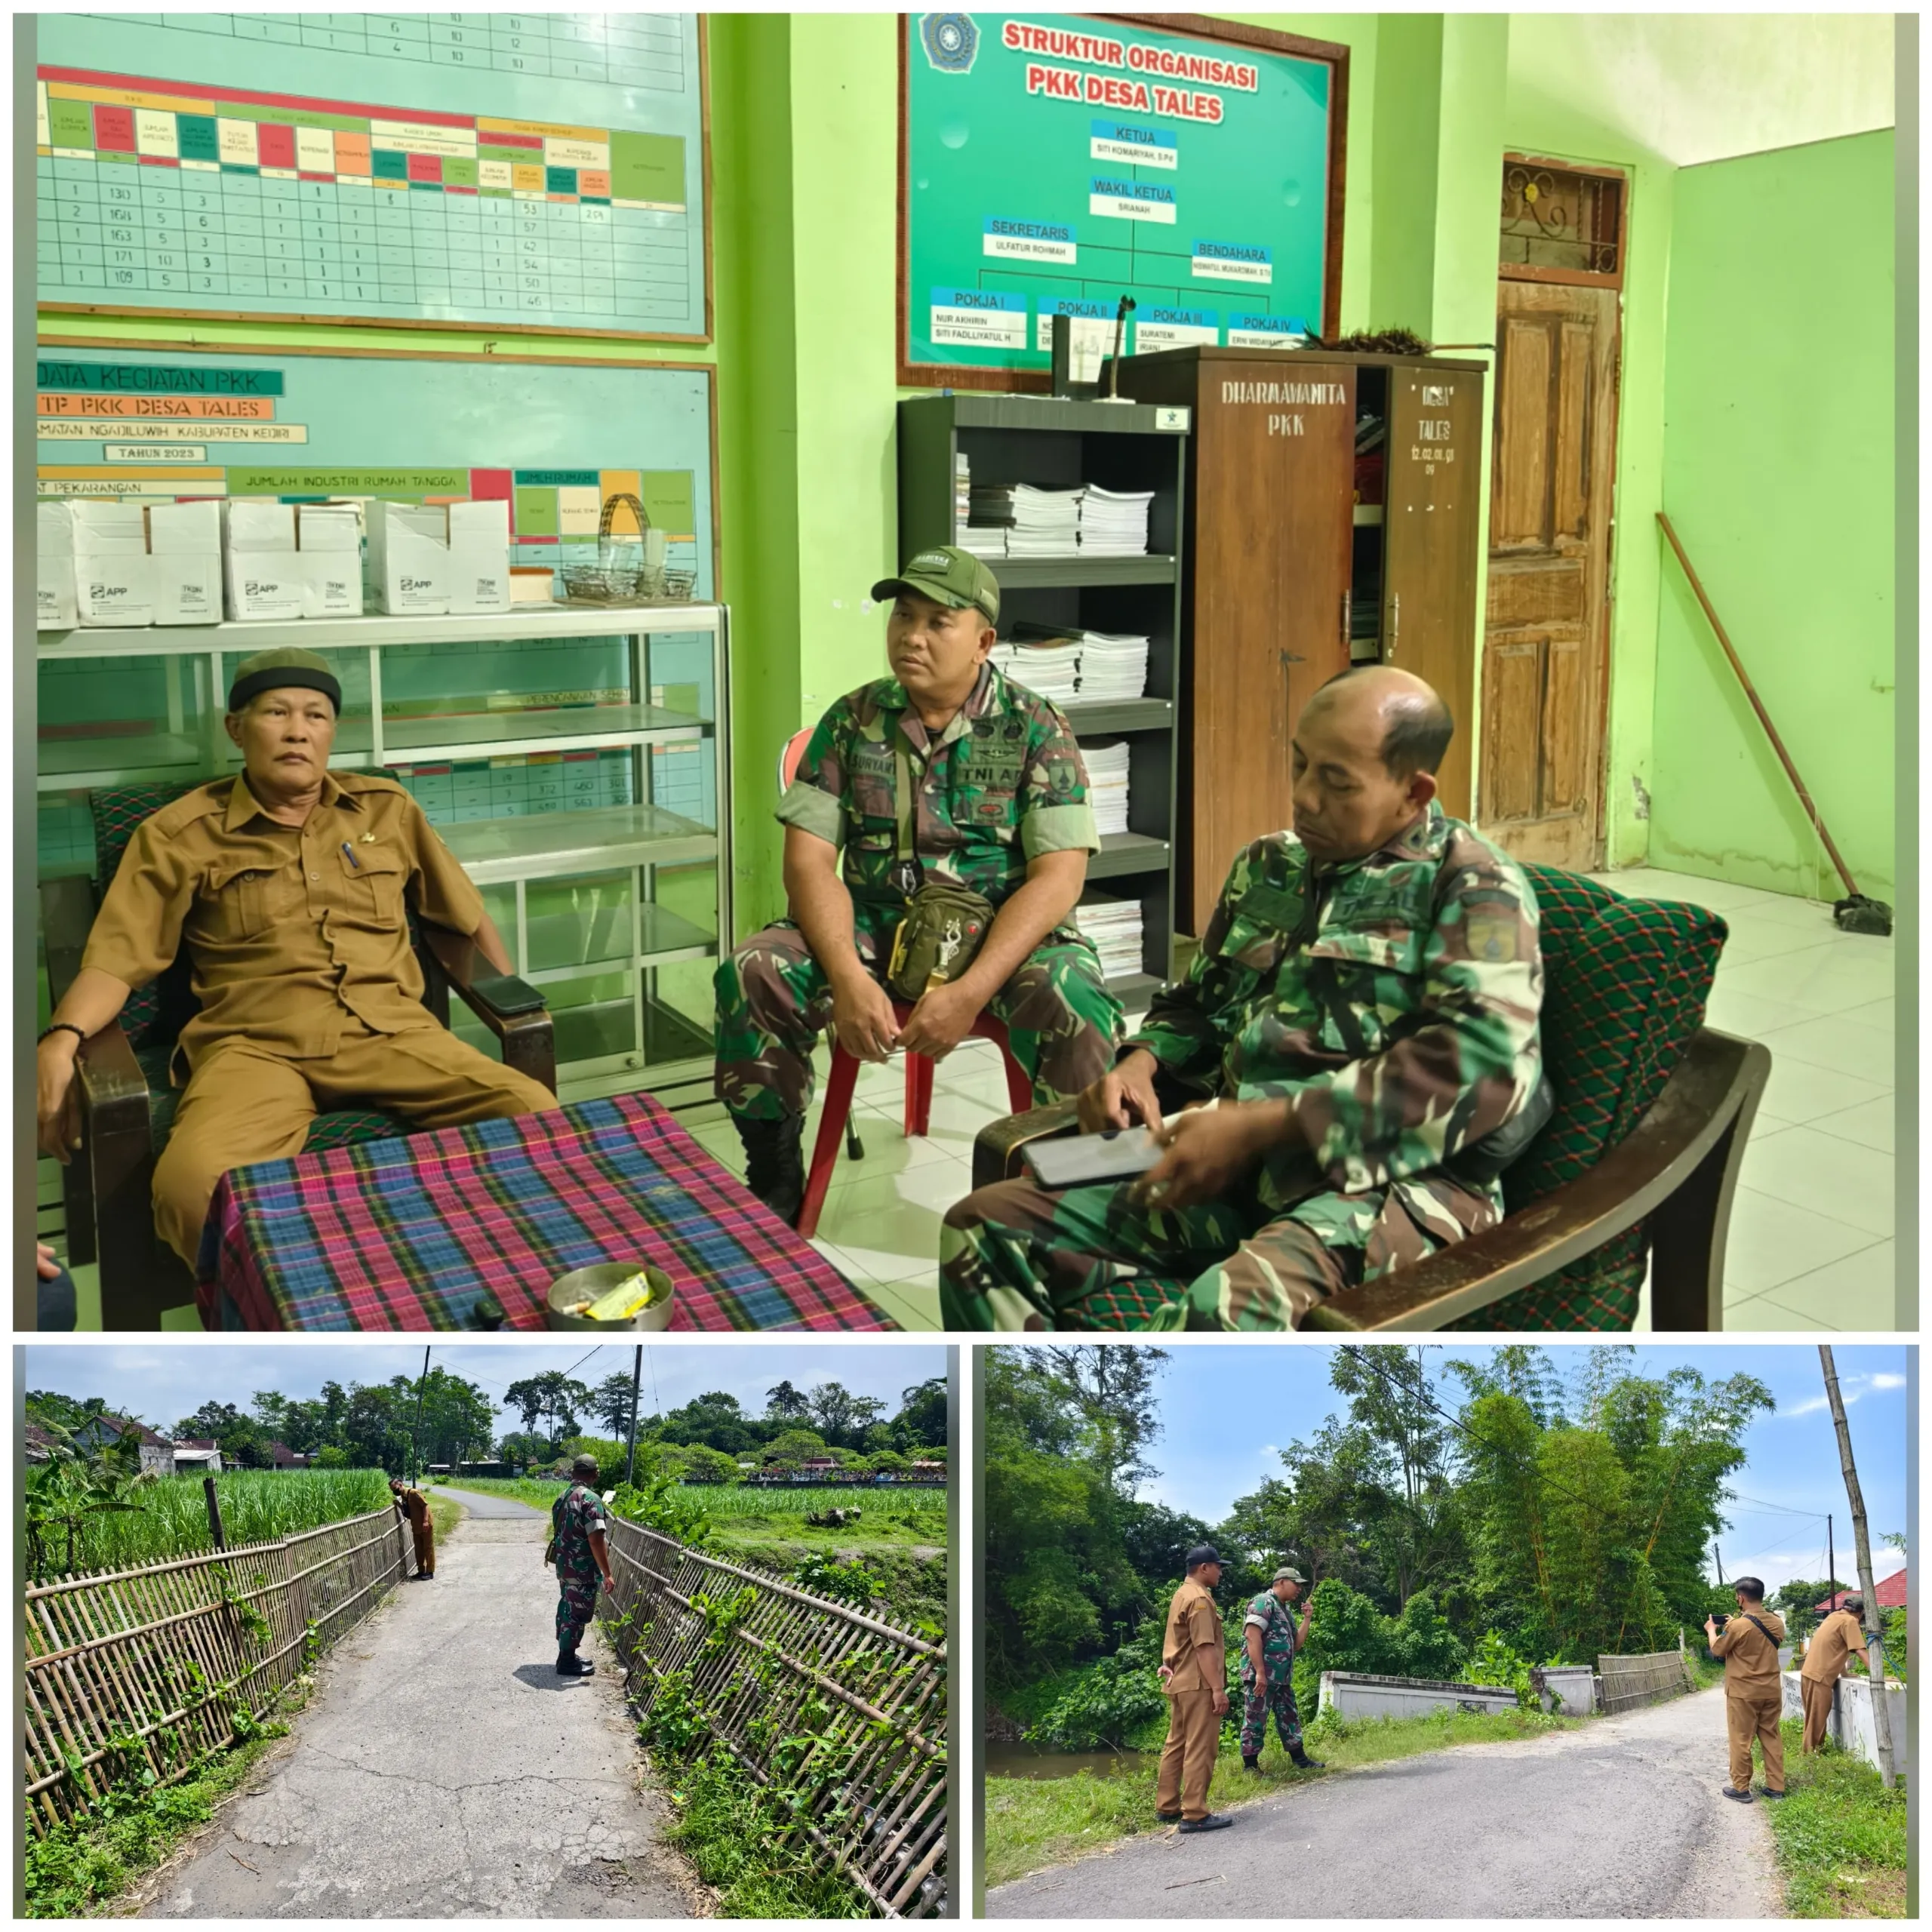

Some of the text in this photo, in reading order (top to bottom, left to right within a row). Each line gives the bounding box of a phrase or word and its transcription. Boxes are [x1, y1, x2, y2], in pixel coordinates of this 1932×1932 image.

[511, 38, 521, 49] 12
[1004, 22, 1123, 65] STRUKTUR
[1128, 45, 1257, 89] ORGANISASI
[1028, 66, 1222, 122] PKK DESA TALES
[1115, 127, 1155, 144] KETUA
[1097, 143, 1111, 154] SITI
[110, 187, 131, 200] 130
[156, 192, 165, 204] 5
[198, 195, 207, 207] 3
[1094, 180, 1174, 203] WAKIL KETUA
[1118, 202, 1151, 214] SRIANAH
[72, 205, 81, 217] 2
[156, 212, 166, 224] 5
[198, 215, 208, 227] 6
[523, 241, 537, 252] 42
[992, 220, 1069, 241] SEKRETARIS
[111, 229, 132, 242] 163
[158, 232, 168, 244] 5
[201, 237, 208, 248] 3
[995, 241, 1066, 257] ULFATUR ROHMAH
[1198, 243, 1266, 262] BENDAHARA
[115, 250, 133, 262] 171
[157, 254, 173, 266] 10
[203, 256, 211, 268] 3
[115, 269, 134, 284] 109
[161, 273, 171, 286] 5
[203, 276, 211, 288] 3
[954, 292, 998, 309] POKJA
[1058, 301, 1108, 317] POKJA II
[1153, 309, 1203, 324] POKJA III
[936, 313, 988, 326] NUR AKHIRIN
[1244, 316, 1291, 332] POKJA IV
[935, 328, 951, 339] SITI
[1004, 334, 1011, 343] H
[1140, 328, 1175, 340] SURATEMI
[38, 363, 260, 392] DATA KEGIATAN PKK
[1221, 380, 1346, 405] DHARMAWANITA
[42, 395, 259, 417] TP PKK DESA TALES
[90, 425, 169, 437] NGADILUWIH
[177, 426, 249, 438] KABUPATEN
[1268, 414, 1305, 436] PKK
[1418, 420, 1451, 441] TALES
[118, 448, 195, 459] TAHUN 2023
[54, 482, 142, 494] PEKARANGAN
[246, 475, 457, 487] JUMLAH INDUSTRI RUMAH TANGGA
[106, 587, 128, 596] APP
[260, 584, 278, 592] APP
[414, 580, 432, 589] APP
[962, 767, 993, 781] TNI
